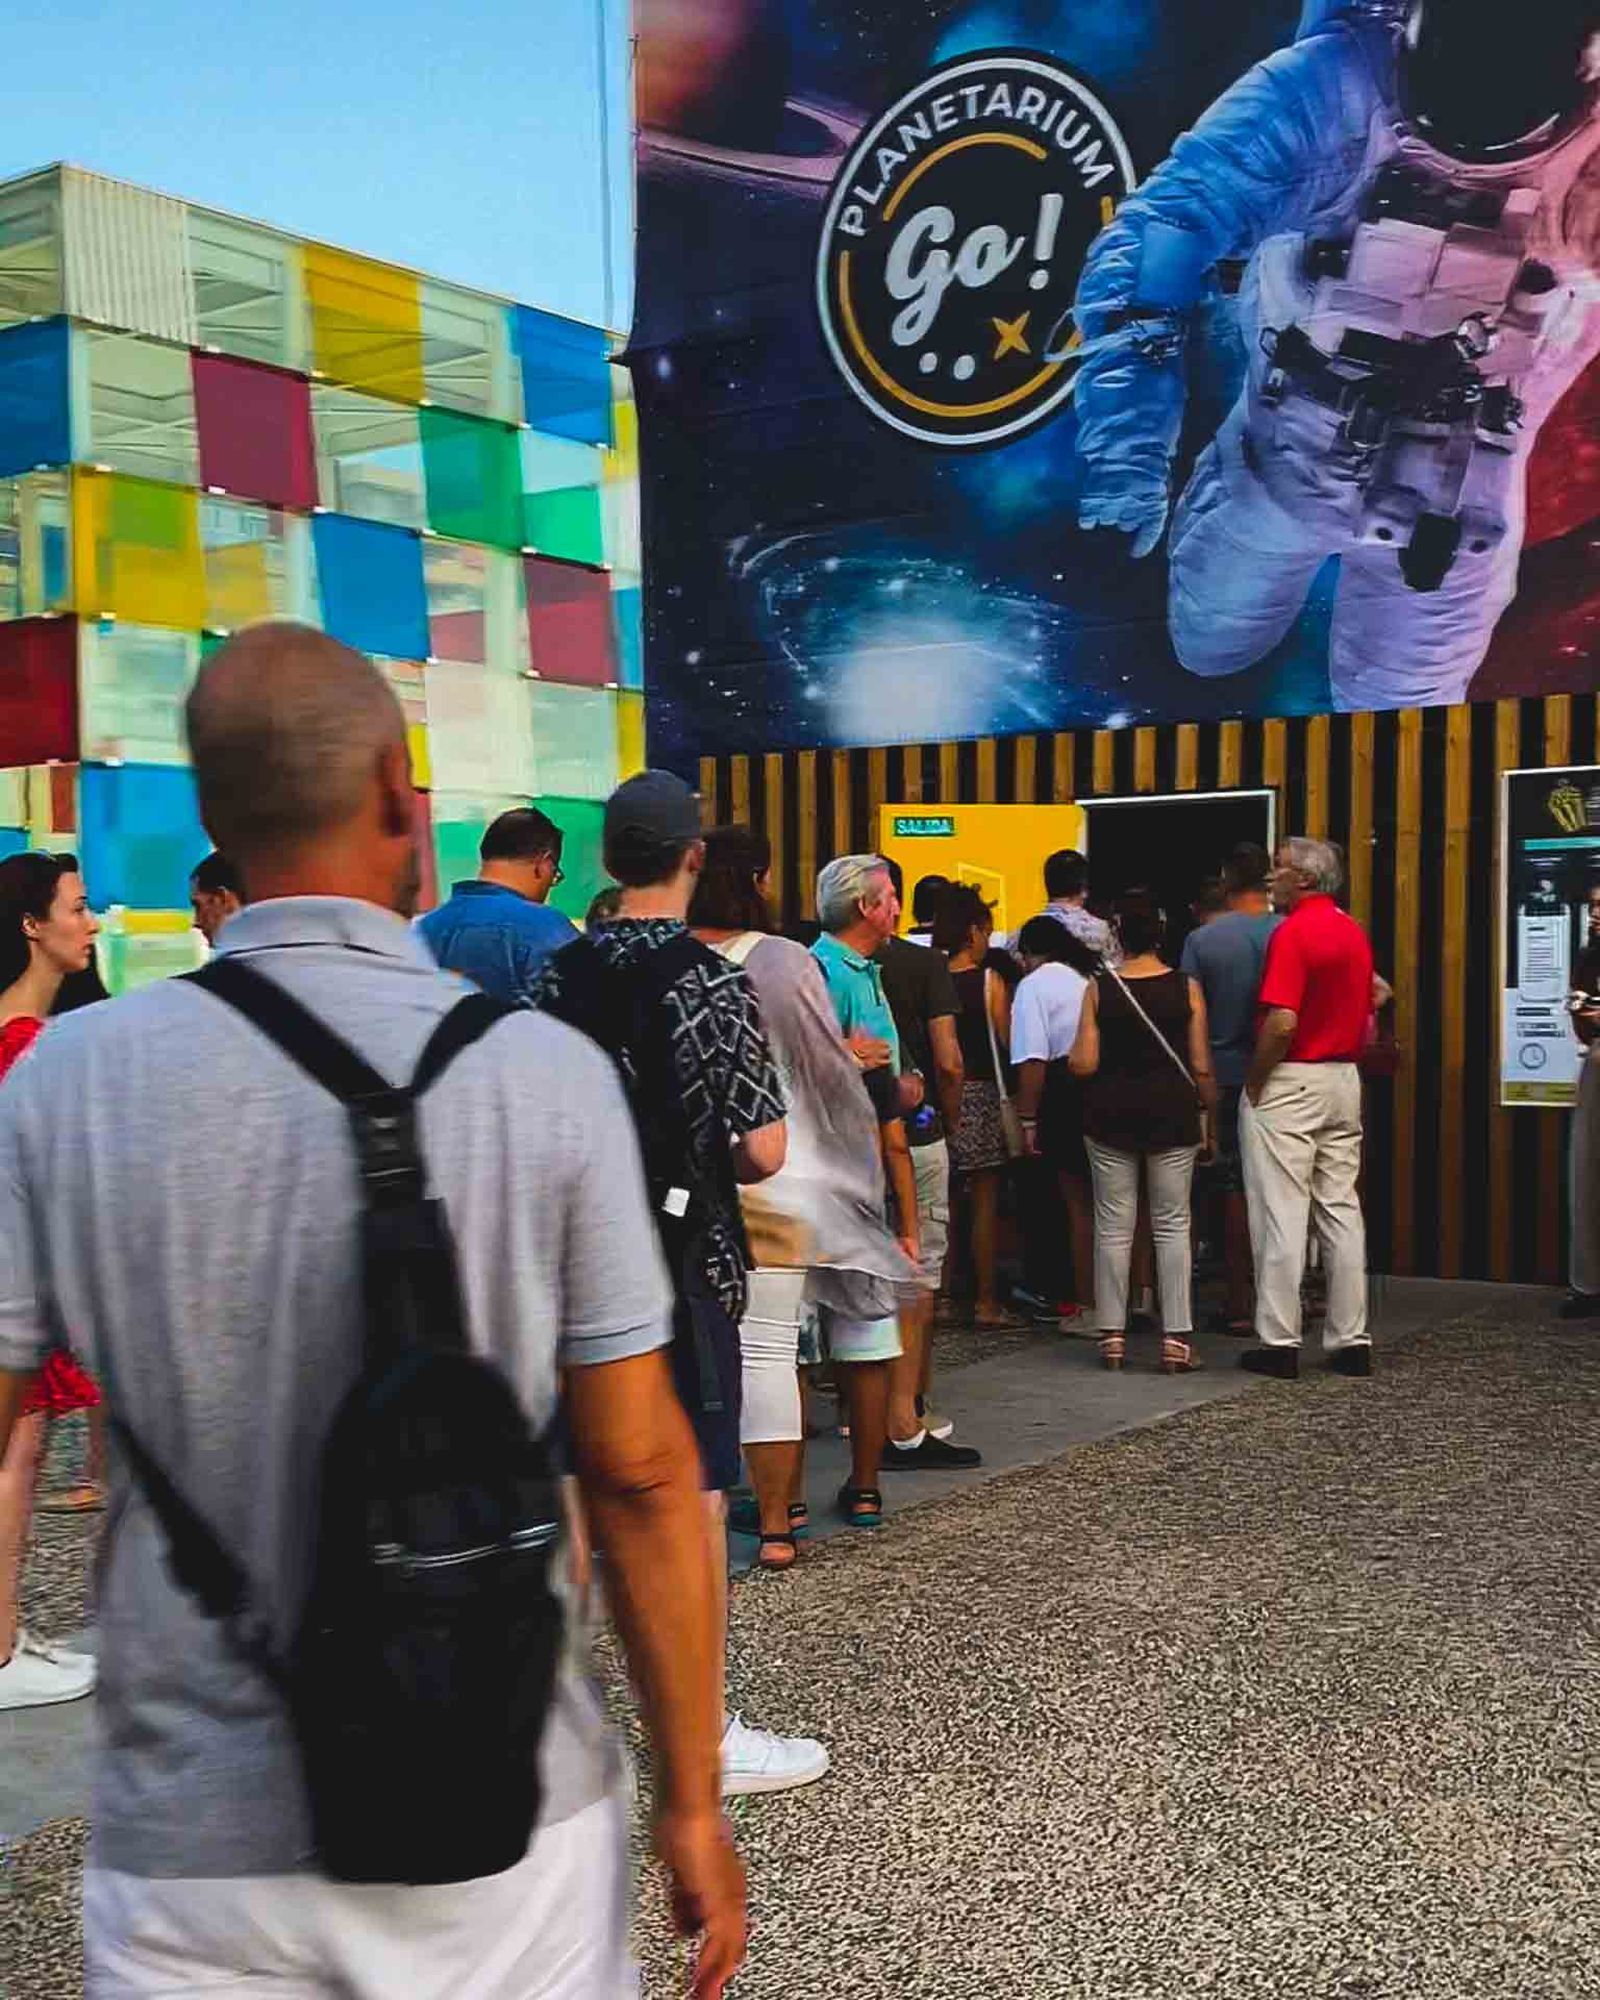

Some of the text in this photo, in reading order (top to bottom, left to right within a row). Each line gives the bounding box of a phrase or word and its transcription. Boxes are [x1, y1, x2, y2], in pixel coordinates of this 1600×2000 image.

[838, 82, 1115, 236] PLANETARIUM
[884, 192, 1064, 347] Go!
[897, 819, 953, 834] SALIDA
